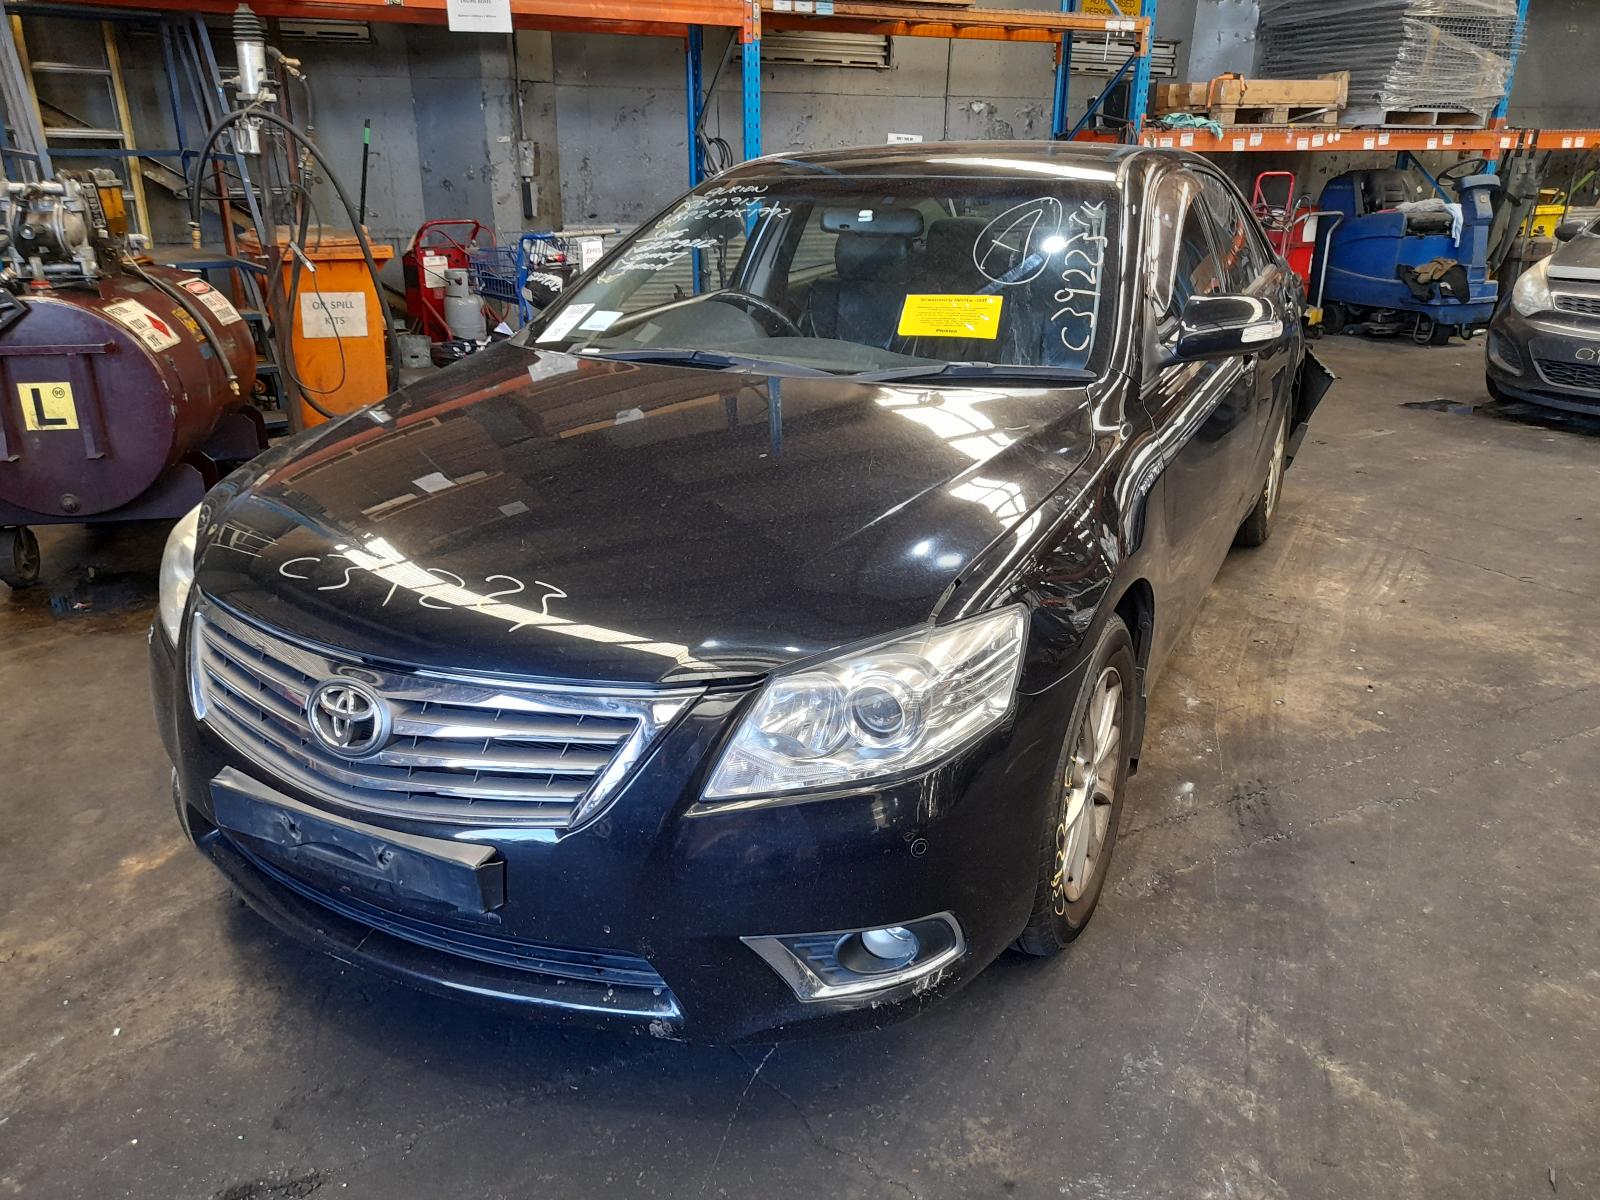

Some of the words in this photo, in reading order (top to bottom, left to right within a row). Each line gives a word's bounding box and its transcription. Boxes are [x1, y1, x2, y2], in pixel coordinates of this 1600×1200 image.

[980, 208, 1043, 270] A
[331, 300, 355, 310] SPILL
[324, 316, 345, 325] KTS
[30, 388, 68, 426] L
